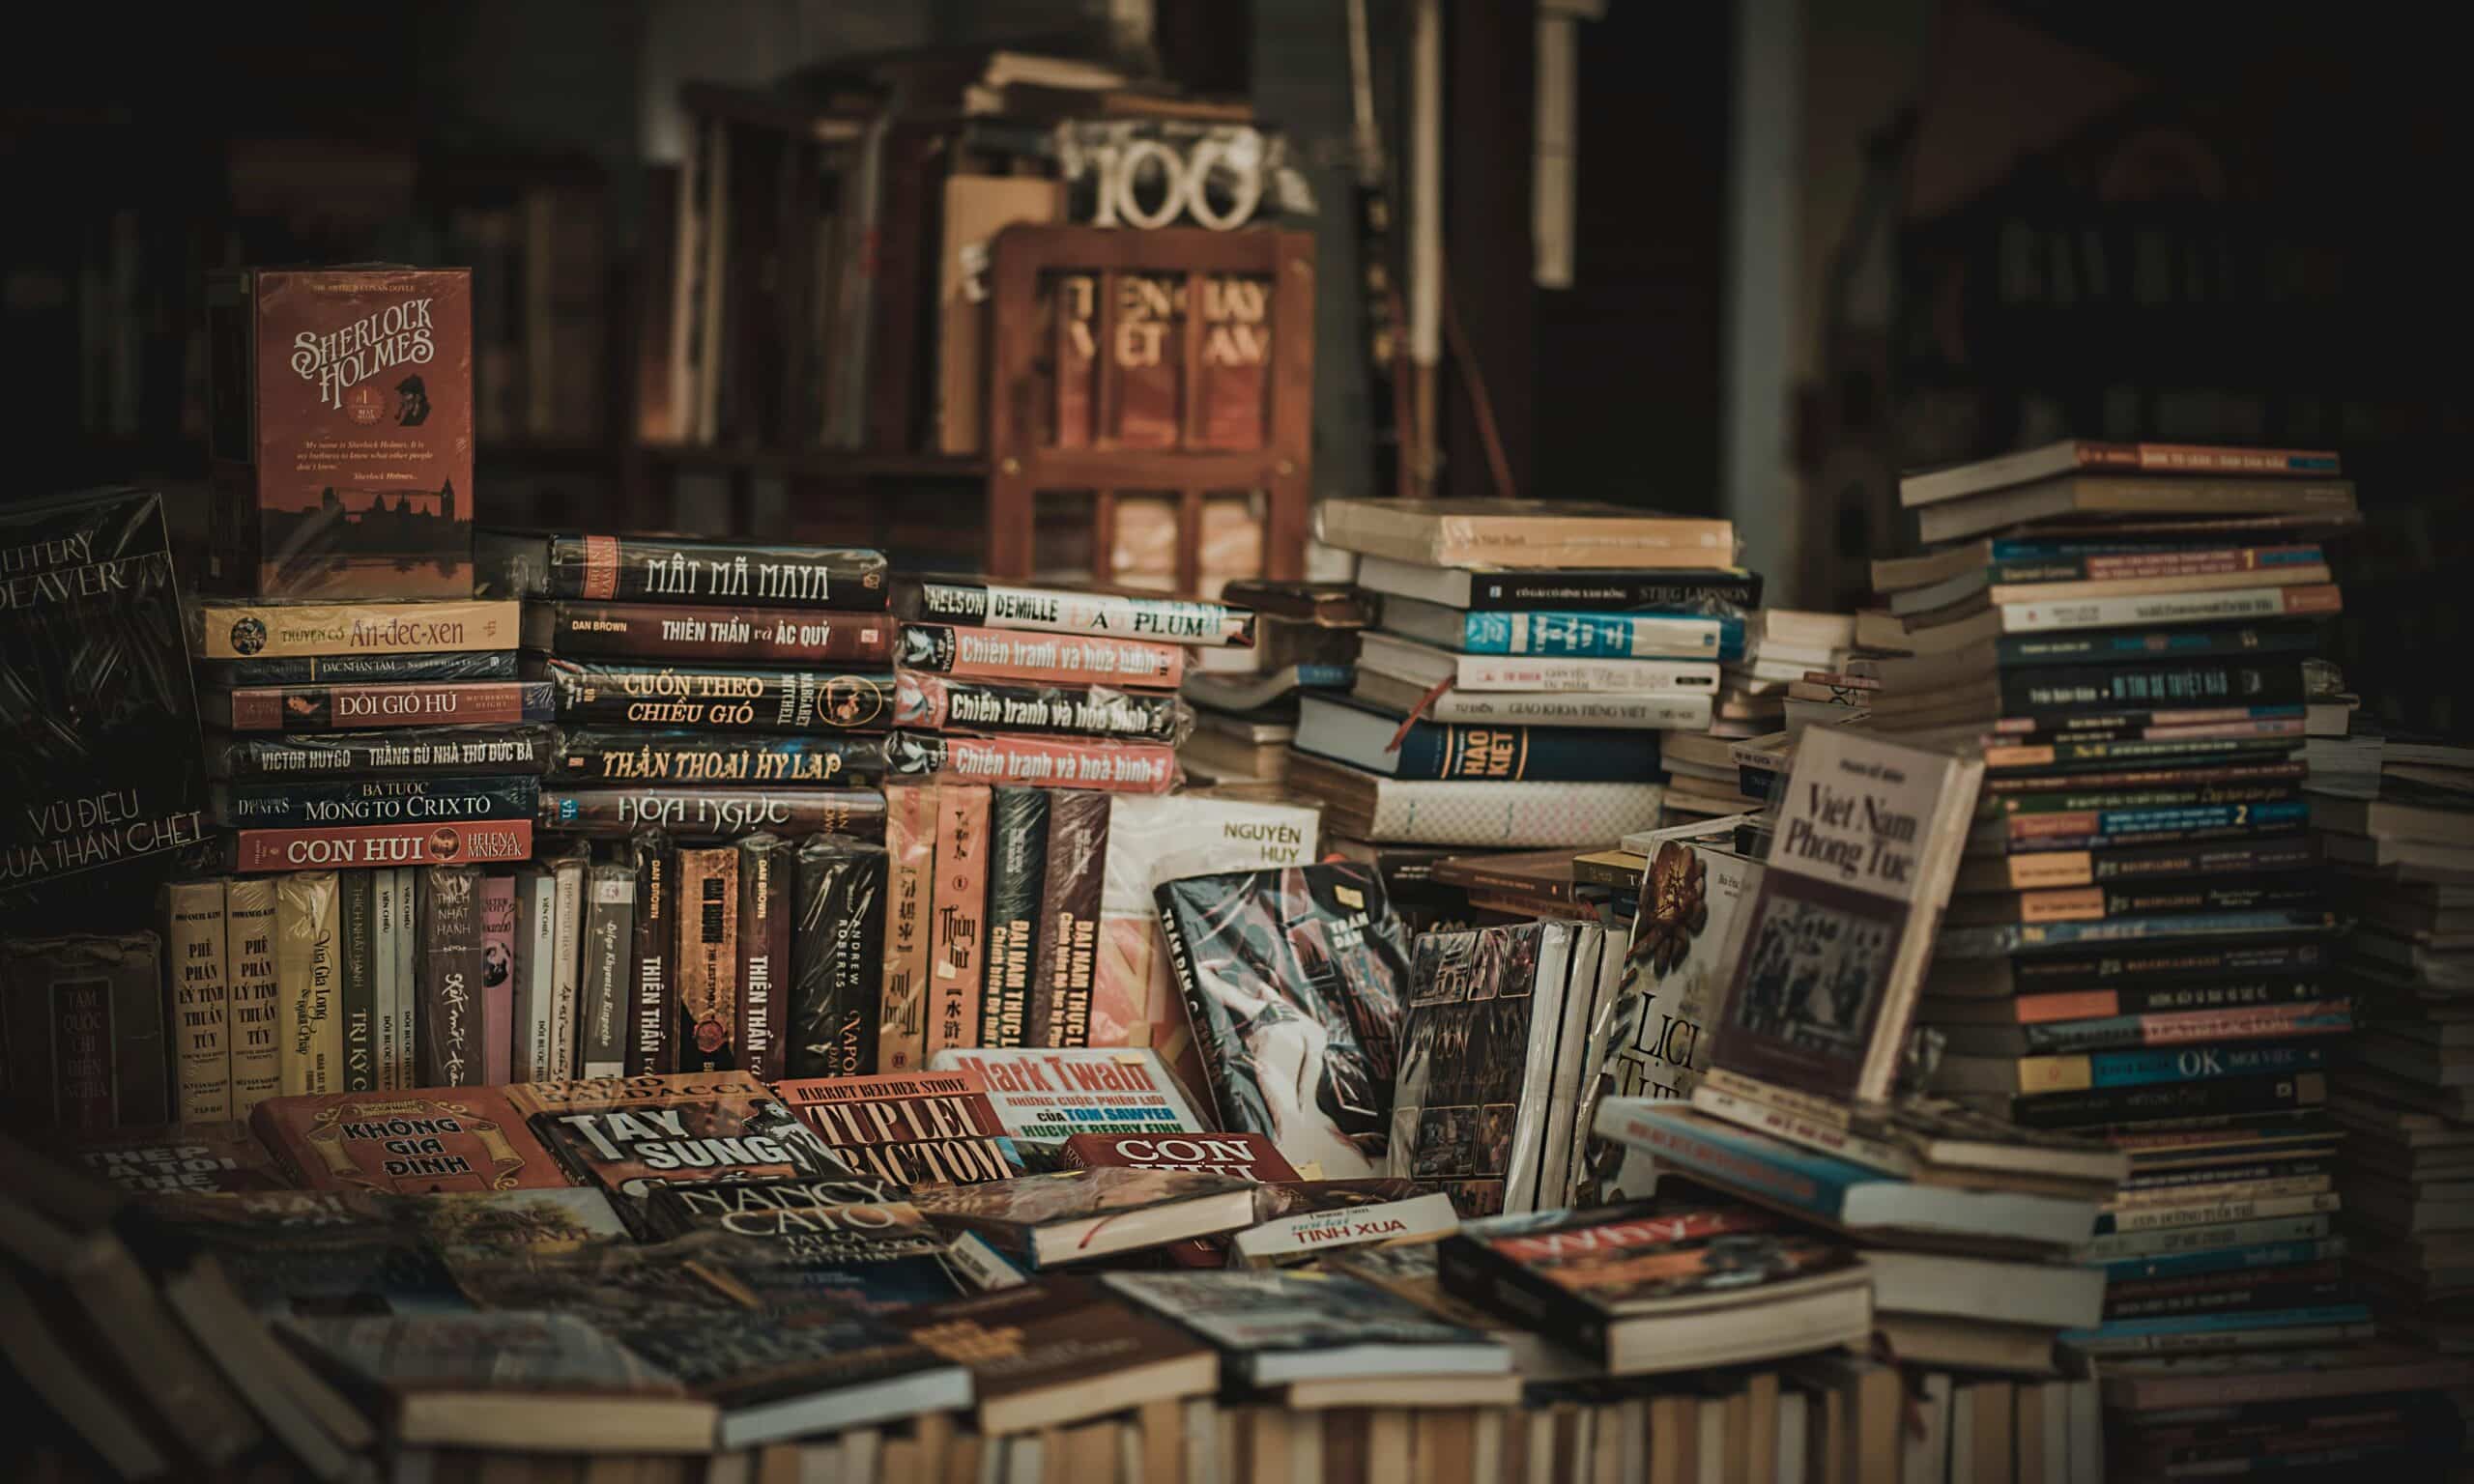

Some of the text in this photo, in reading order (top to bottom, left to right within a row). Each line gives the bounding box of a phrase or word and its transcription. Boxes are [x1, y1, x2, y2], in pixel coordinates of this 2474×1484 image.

[1092, 138, 1262, 231] 100
[291, 298, 434, 380] SHERLOCK
[318, 328, 435, 411] HOLMES
[707, 556, 750, 596] MÃ
[757, 563, 830, 601] MAYA
[1638, 586, 1682, 602] STIEG
[929, 586, 1059, 621] NELSON DEMILLE
[571, 620, 628, 634] DAN BROWN
[661, 616, 707, 642] THIÊN
[710, 614, 751, 643] THẦN
[1134, 613, 1204, 637] PLUM
[961, 633, 1009, 667] Chiến
[1012, 637, 1057, 669] tranh
[1061, 642, 1080, 671] và
[623, 667, 764, 699] CUỐN THEO
[338, 690, 458, 716] ĐỒI GIÓ HÚ
[627, 695, 755, 725] CHIỀU GIÓ
[952, 689, 1002, 722] Chiến
[1003, 696, 1050, 726] tranh
[1052, 699, 1072, 727] và
[1541, 702, 1578, 716] KHOA
[261, 749, 352, 771] VICTOR HUYGO
[368, 739, 410, 766] THẰNG
[414, 742, 430, 765] GÙ
[433, 740, 459, 764] NHÀ
[515, 737, 533, 761] BÀ
[602, 743, 673, 780] THẦN
[955, 745, 1006, 774] Chiến
[1008, 750, 1053, 778] tranh
[1055, 754, 1076, 780] và
[618, 788, 686, 829] HỎA
[697, 792, 791, 833] NGỤC
[286, 839, 357, 864] CON
[467, 832, 518, 846] HELENA
[467, 842, 522, 859] MNISZEK
[1783, 817, 1865, 879] Phong
[651, 859, 662, 879] DAN
[757, 859, 768, 877] DAN
[245, 934, 269, 956] PHÊ
[835, 919, 849, 988] ROBERTS
[849, 920, 862, 985] ANDREW
[185, 962, 217, 982] PHÁN
[241, 957, 273, 978] PHÁN
[1005, 950, 1029, 989] NAM
[1069, 950, 1092, 989] NAM
[234, 981, 250, 1001] LÝ
[308, 987, 331, 1025] Long
[640, 956, 667, 1053] THIÊN THẦN
[747, 955, 774, 1051] THIÊN THẦN
[349, 1008, 367, 1041] TRI
[998, 989, 1024, 1037] THỰC
[1064, 989, 1088, 1037] THỰC
[957, 1056, 1158, 1093] Mark Twain
[2176, 1048, 2224, 1077] OK
[796, 1077, 968, 1101] HARRIET BEECHER STOWE
[342, 1117, 464, 1140] KHÔNG
[1036, 1106, 1177, 1123] CỦA TOM SAWYER
[384, 1138, 446, 1156] GIA
[558, 1109, 689, 1160] TAY
[1114, 1139, 1258, 1162] CON
[677, 1179, 890, 1214] NANCY
[720, 1206, 897, 1237] CATO
